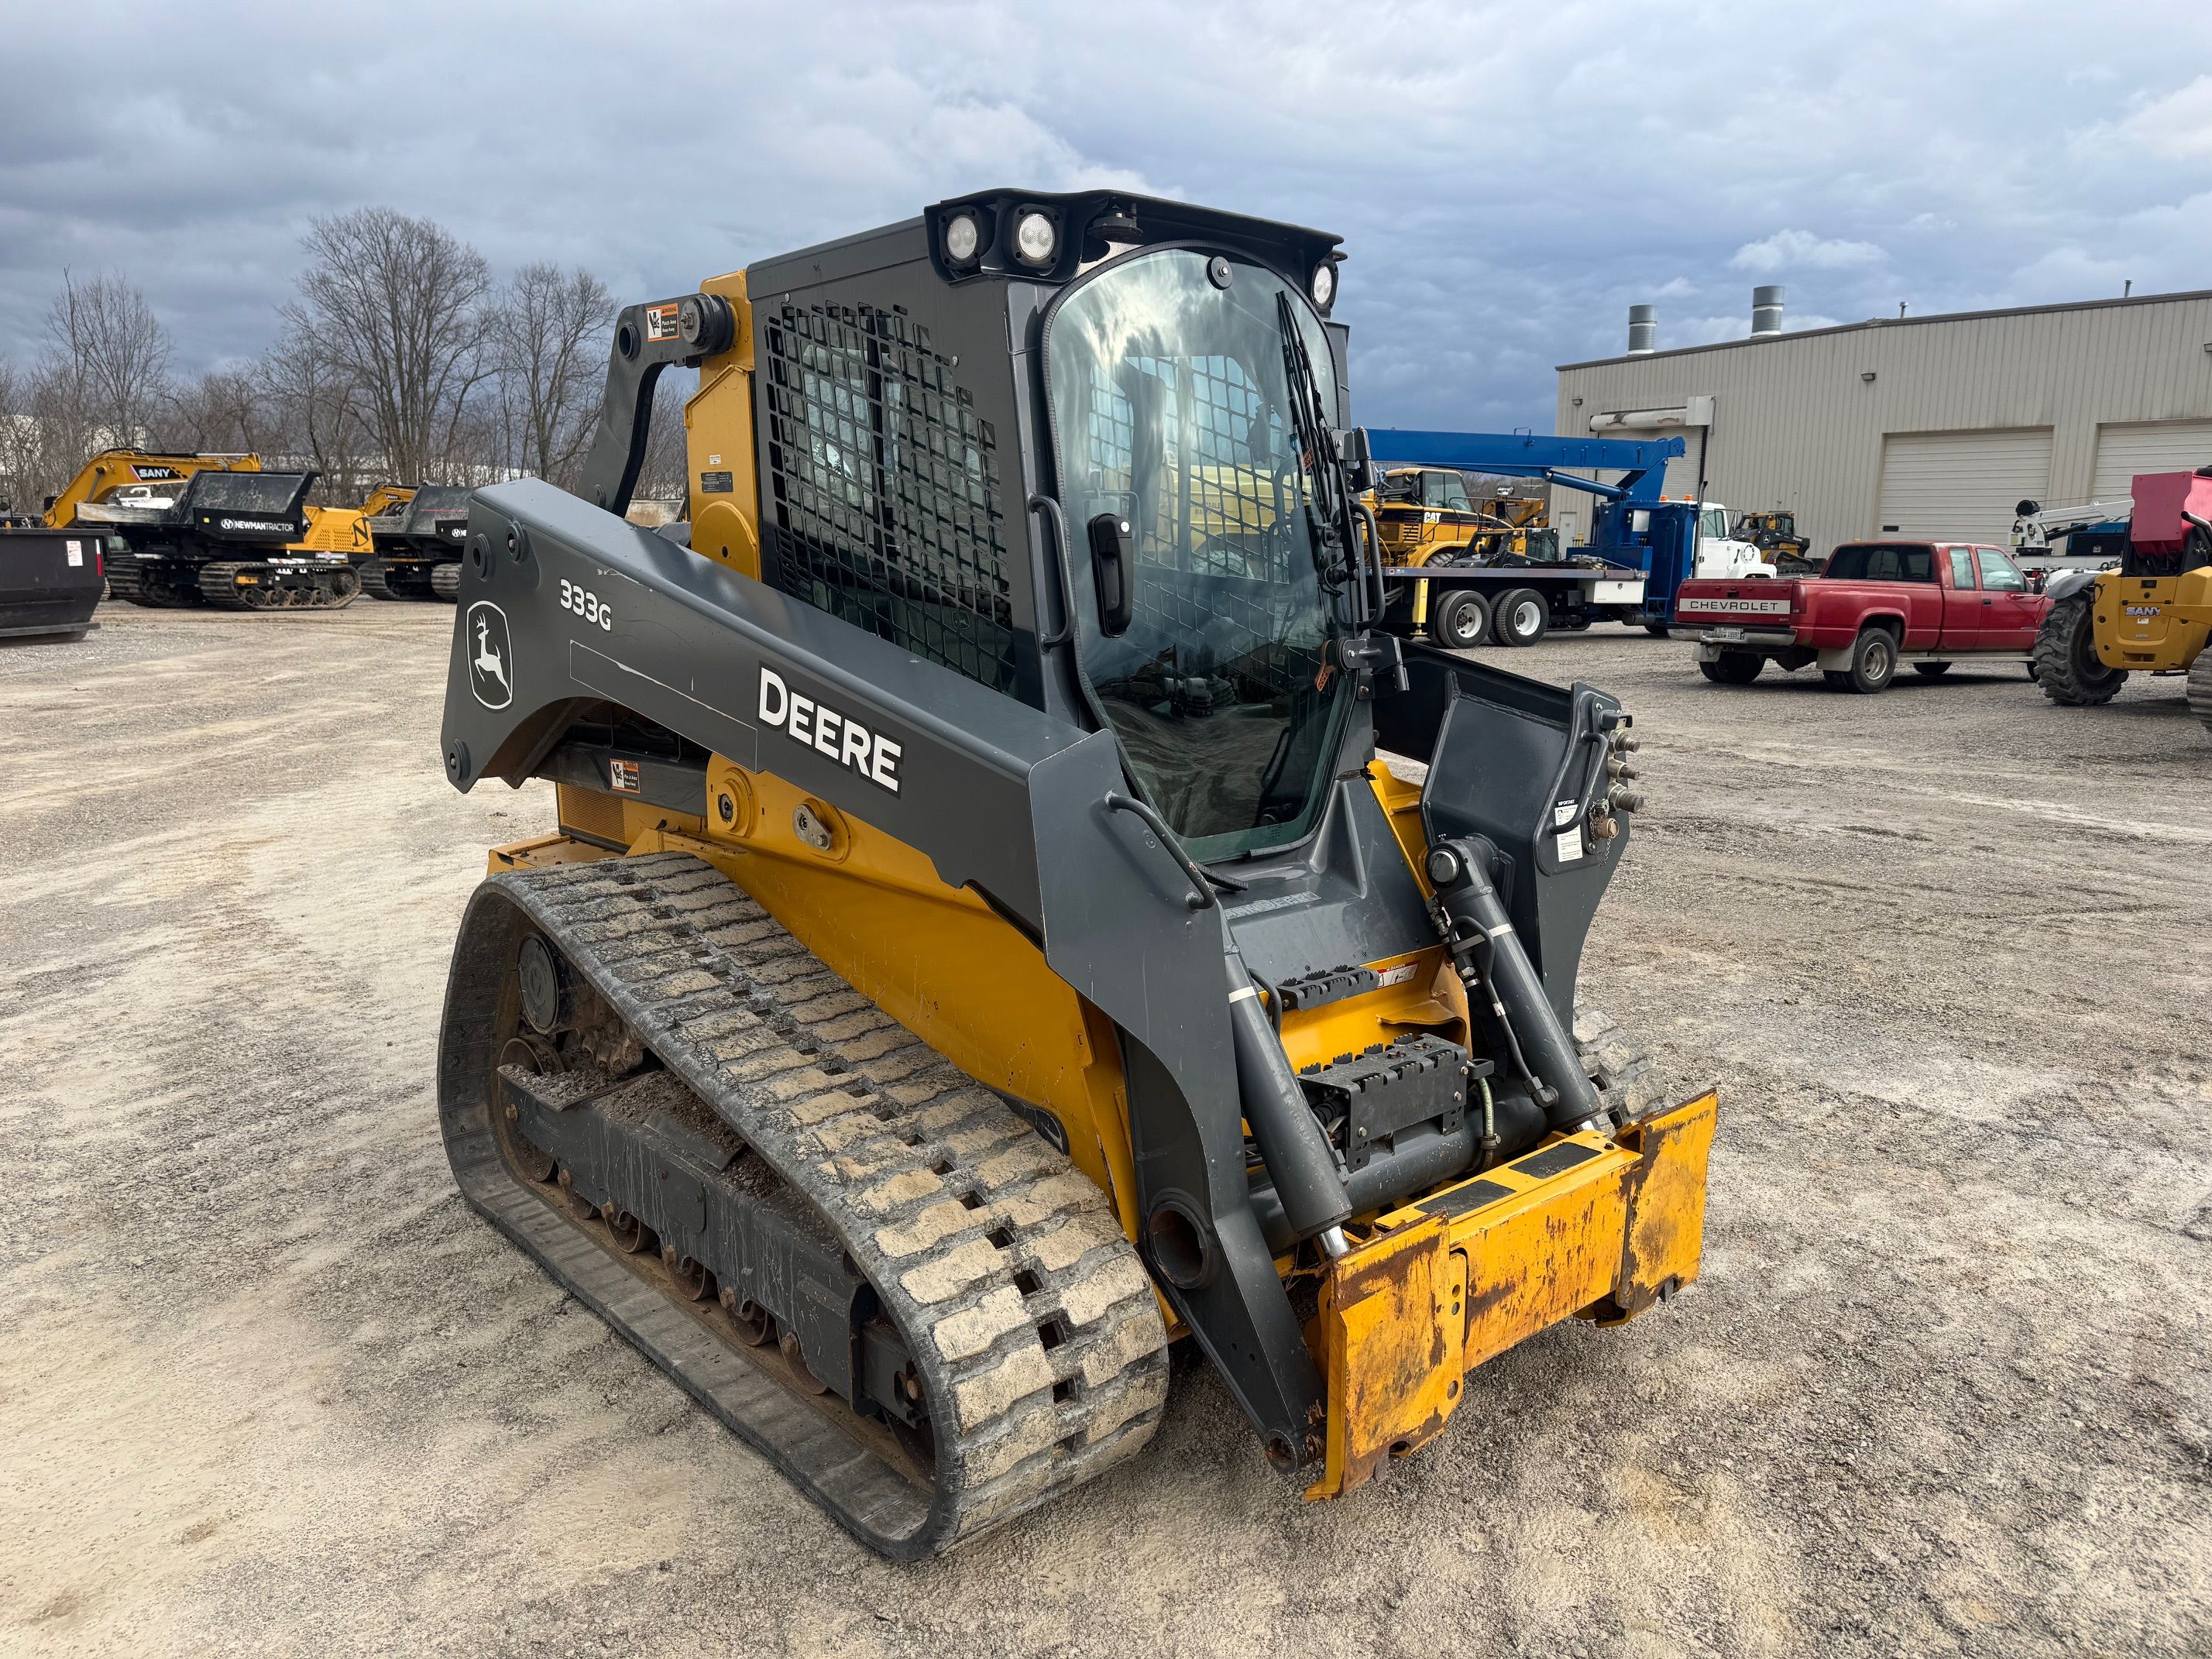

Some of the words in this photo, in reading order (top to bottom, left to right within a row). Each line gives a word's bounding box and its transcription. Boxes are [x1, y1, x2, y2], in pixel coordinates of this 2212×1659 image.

[139, 469, 170, 478] SANY
[1424, 511, 1441, 524] CAT
[560, 579, 612, 631] 333G
[1690, 600, 1779, 611] CHEVROLET
[2125, 606, 2161, 616] SANY
[759, 667, 902, 792] DEERE
